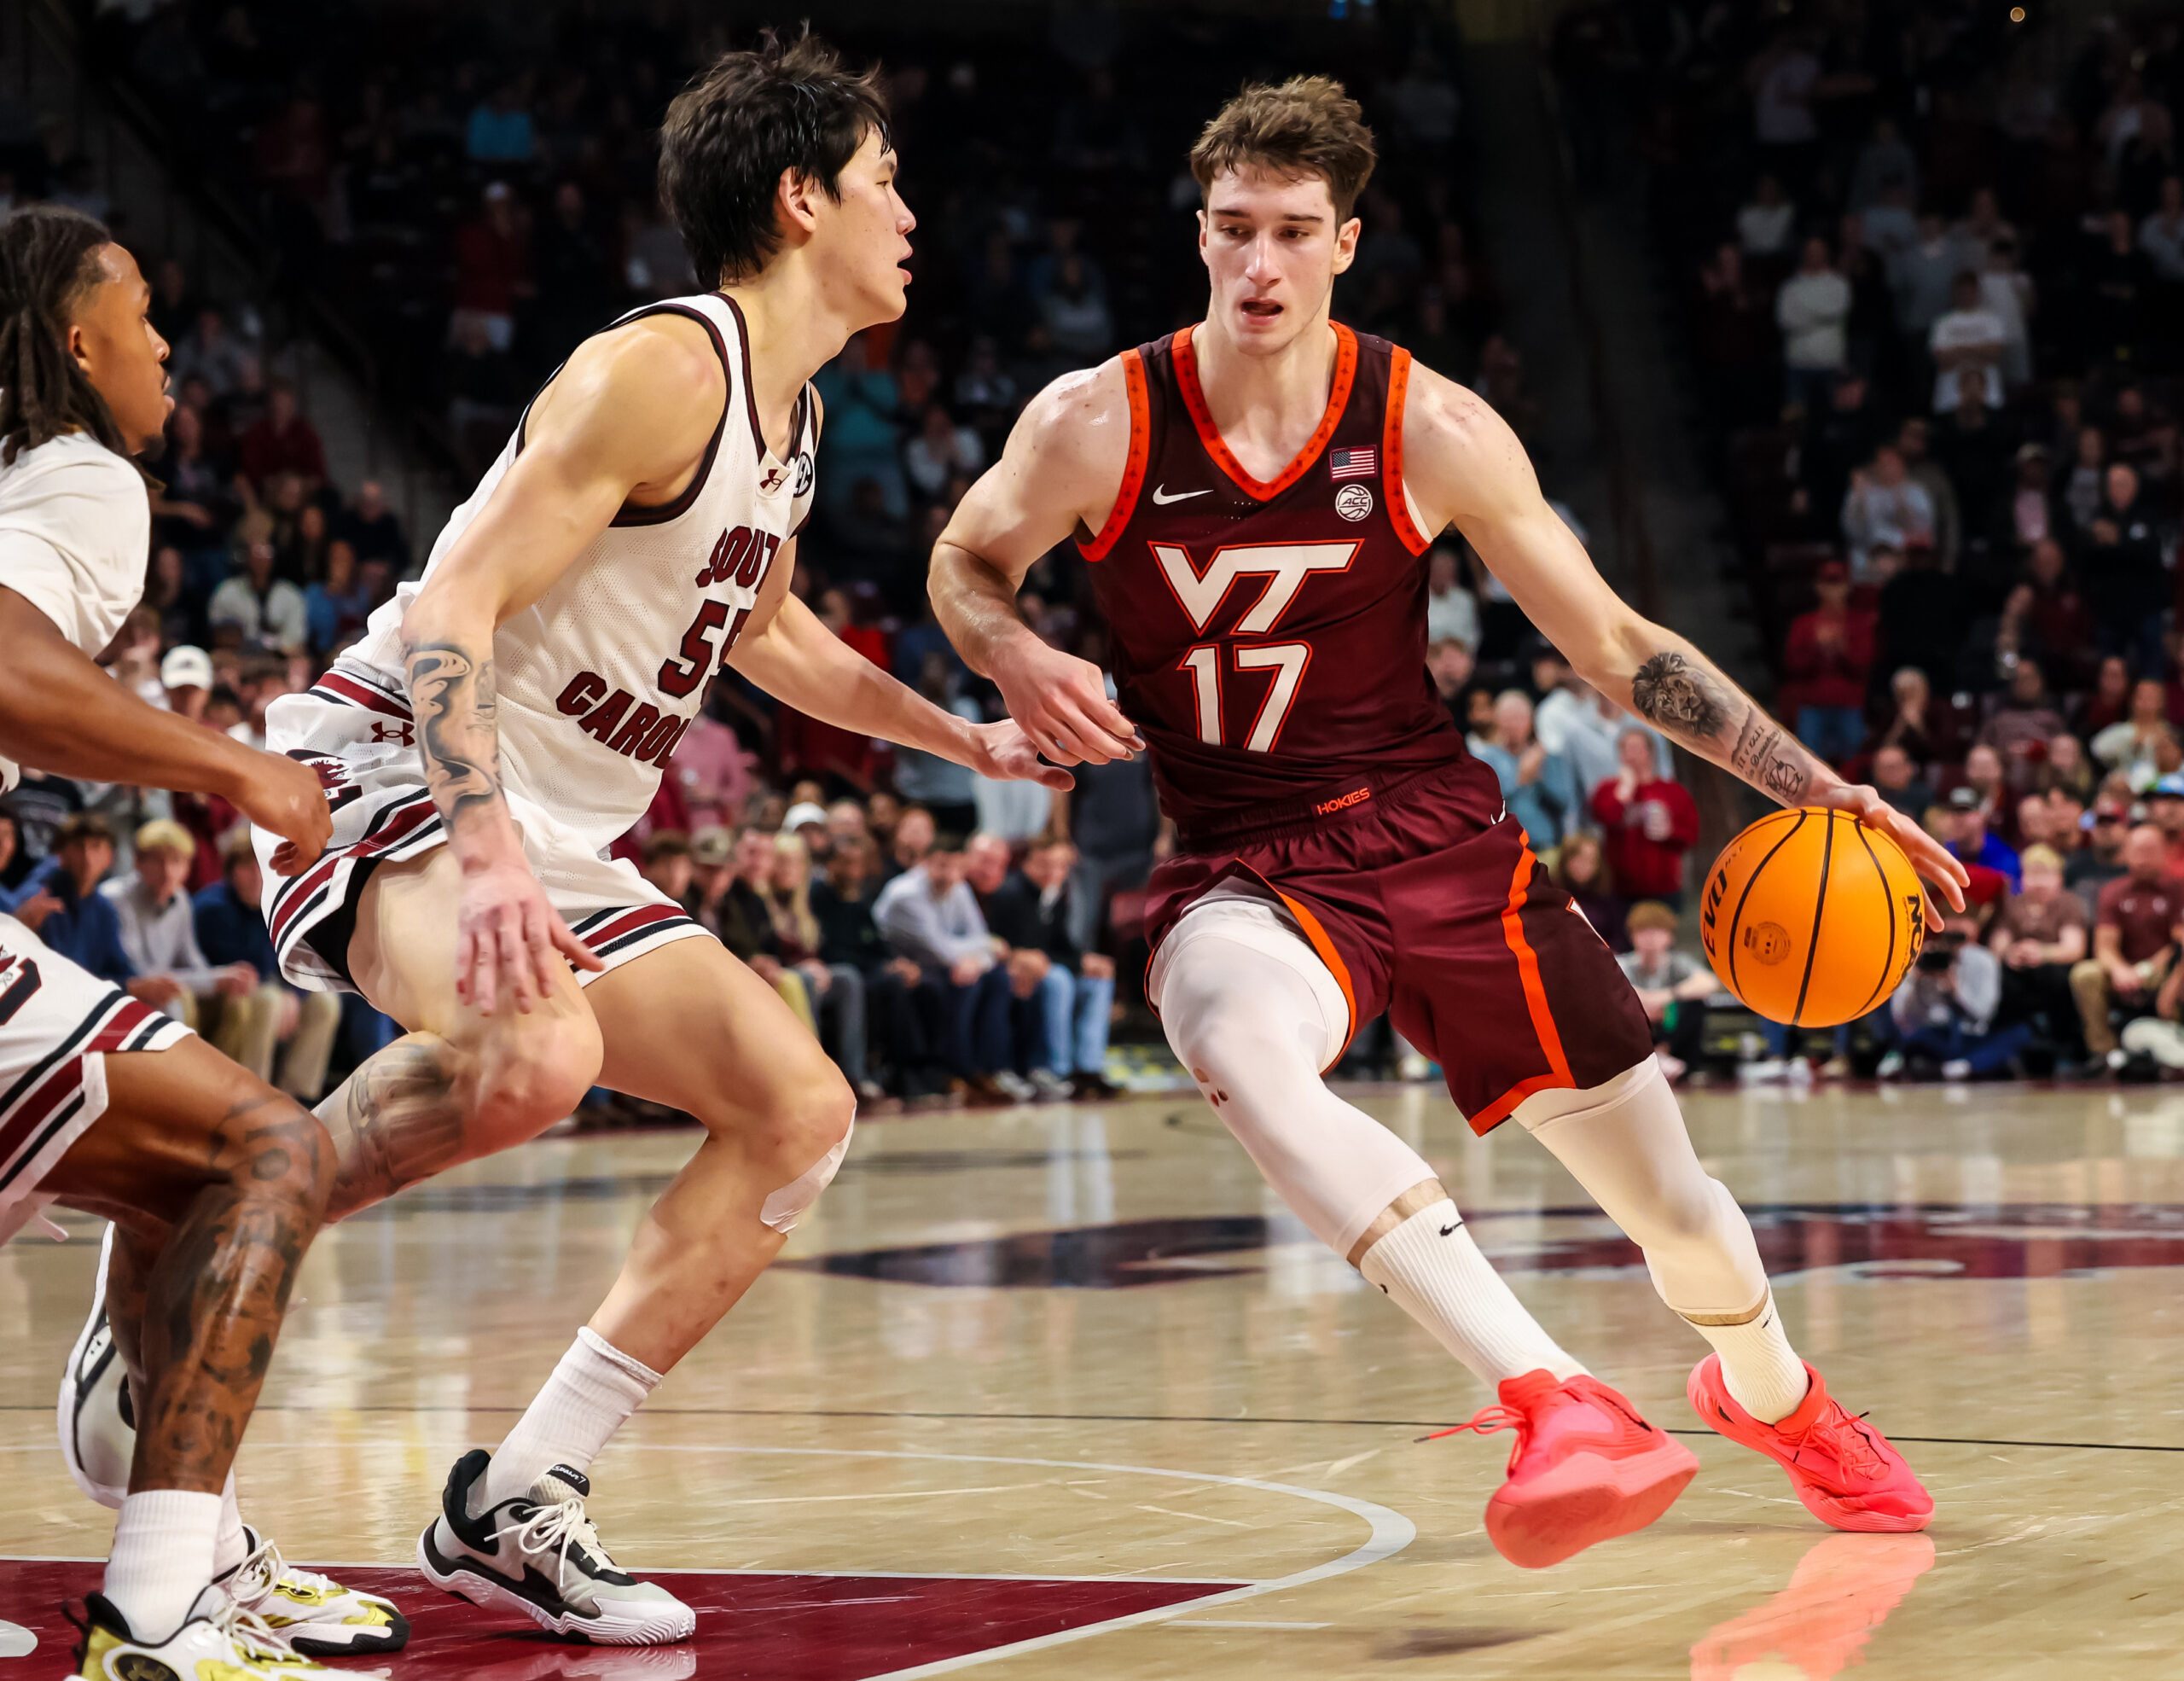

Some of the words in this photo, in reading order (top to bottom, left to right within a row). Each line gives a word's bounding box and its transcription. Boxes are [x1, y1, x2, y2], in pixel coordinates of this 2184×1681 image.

[1341, 496, 1370, 506] ACC
[1147, 538, 1365, 637] VT
[1177, 640, 1313, 753] 17
[1316, 787, 1370, 816] HOKIES
[1704, 869, 1728, 958] EVO
